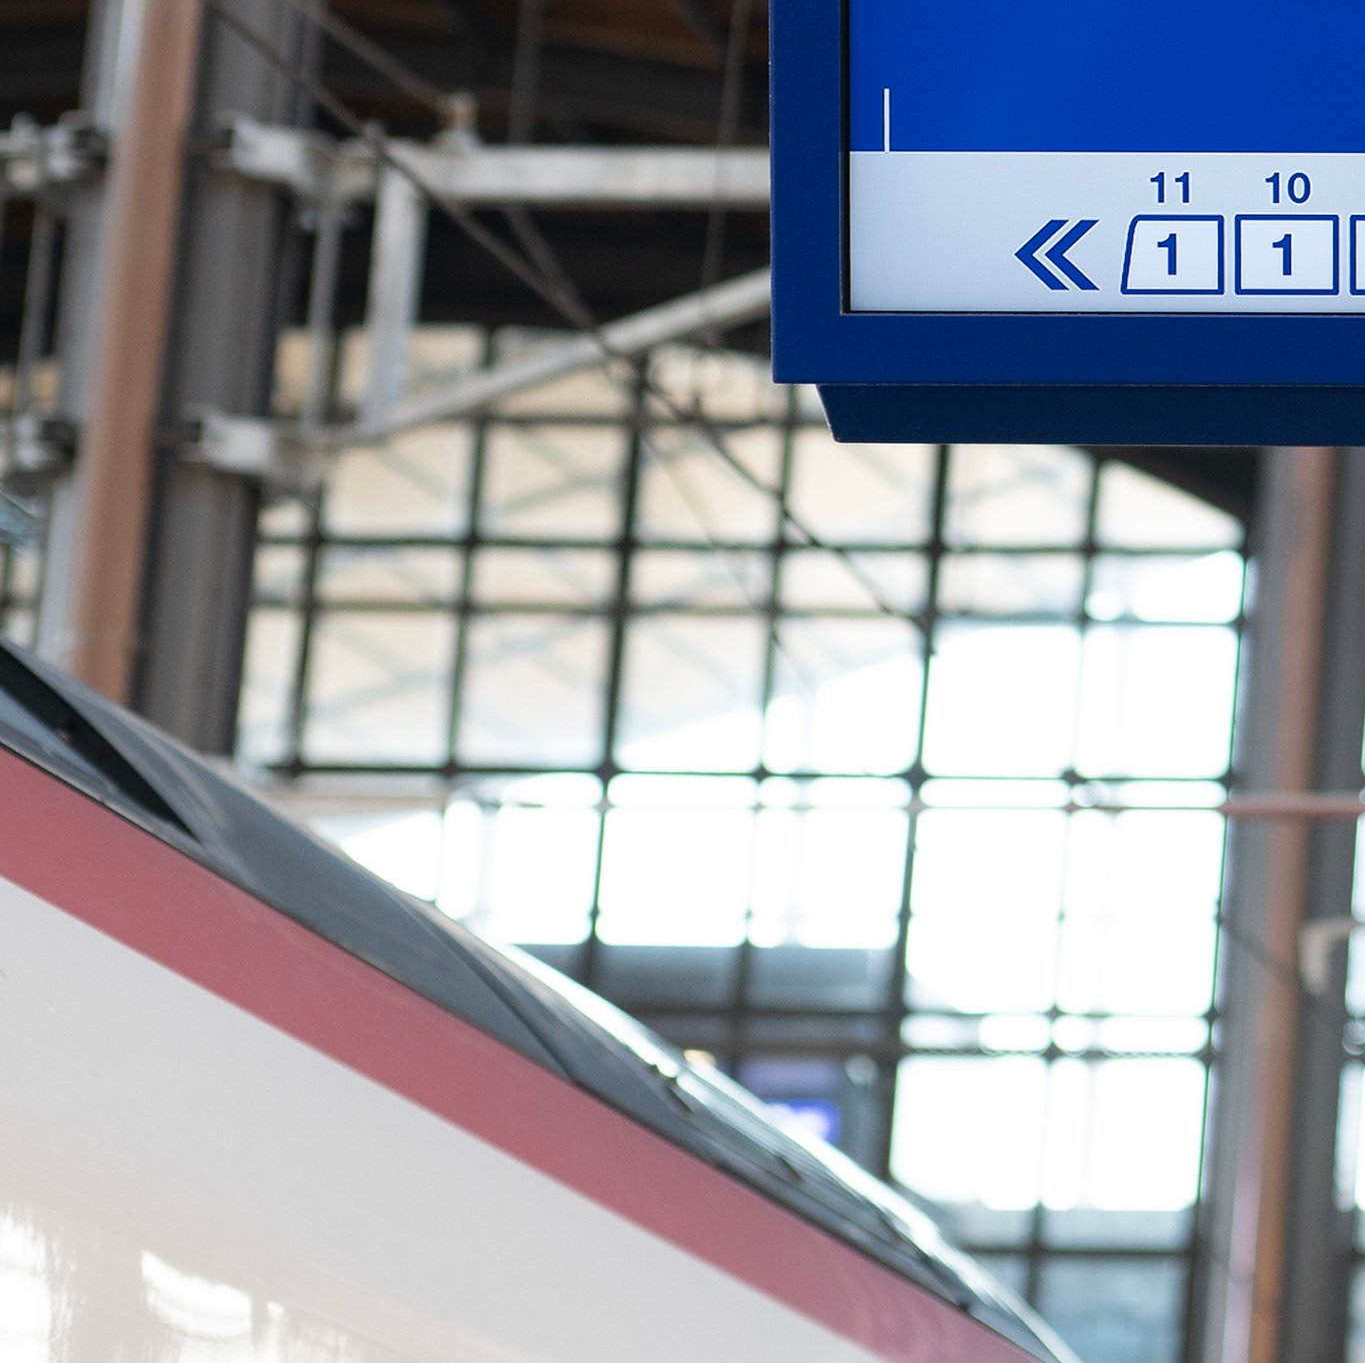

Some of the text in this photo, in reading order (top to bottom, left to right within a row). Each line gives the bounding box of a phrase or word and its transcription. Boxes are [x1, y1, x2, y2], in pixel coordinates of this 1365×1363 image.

[1148, 171, 1191, 204] 11
[1263, 171, 1312, 204] 10
[1155, 232, 1179, 276] 1
[1270, 233, 1294, 277] 1
